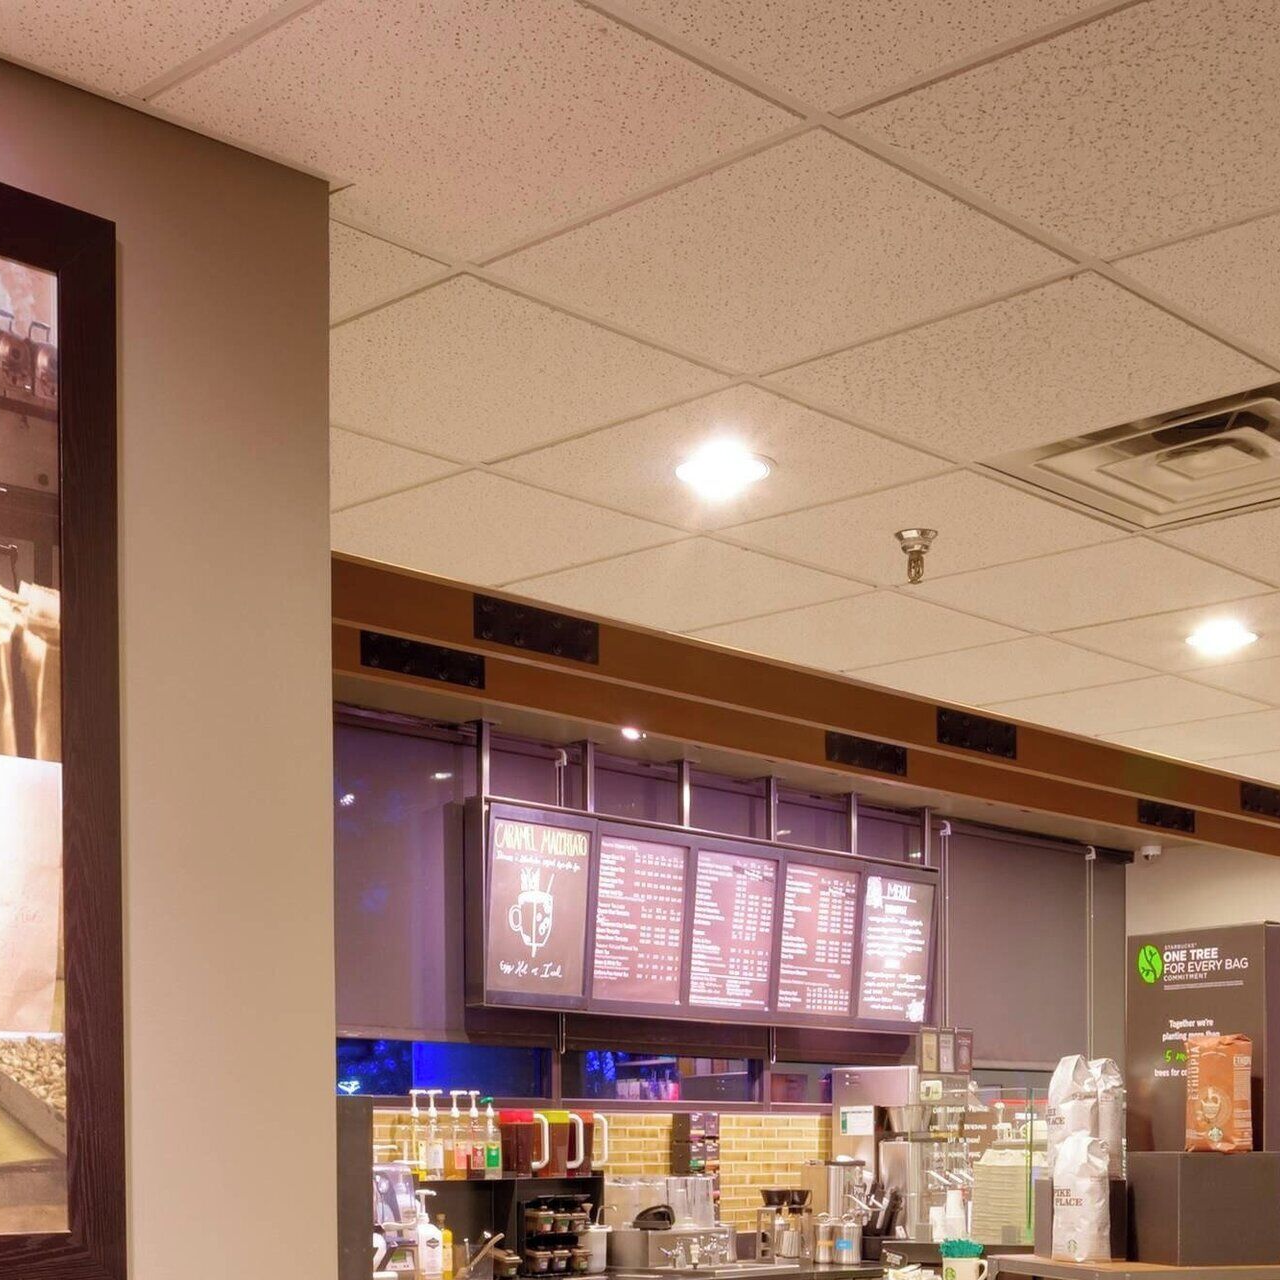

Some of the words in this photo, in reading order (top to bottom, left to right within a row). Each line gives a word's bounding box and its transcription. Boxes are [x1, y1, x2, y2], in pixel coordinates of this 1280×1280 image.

[1163, 949, 1187, 962] ONE
[1189, 947, 1219, 961] TREE
[1163, 962, 1185, 974] FOR
[1187, 960, 1222, 973] EVERY
[1225, 957, 1249, 970] BAG
[1163, 972, 1208, 982] COMMITMENT
[1169, 1018, 1195, 1030] Together
[1162, 1032, 1187, 1043] planting
[1154, 1068, 1170, 1077] trees
[1171, 1067, 1180, 1077] for
[1190, 1045, 1200, 1100] ETHIOPIA
